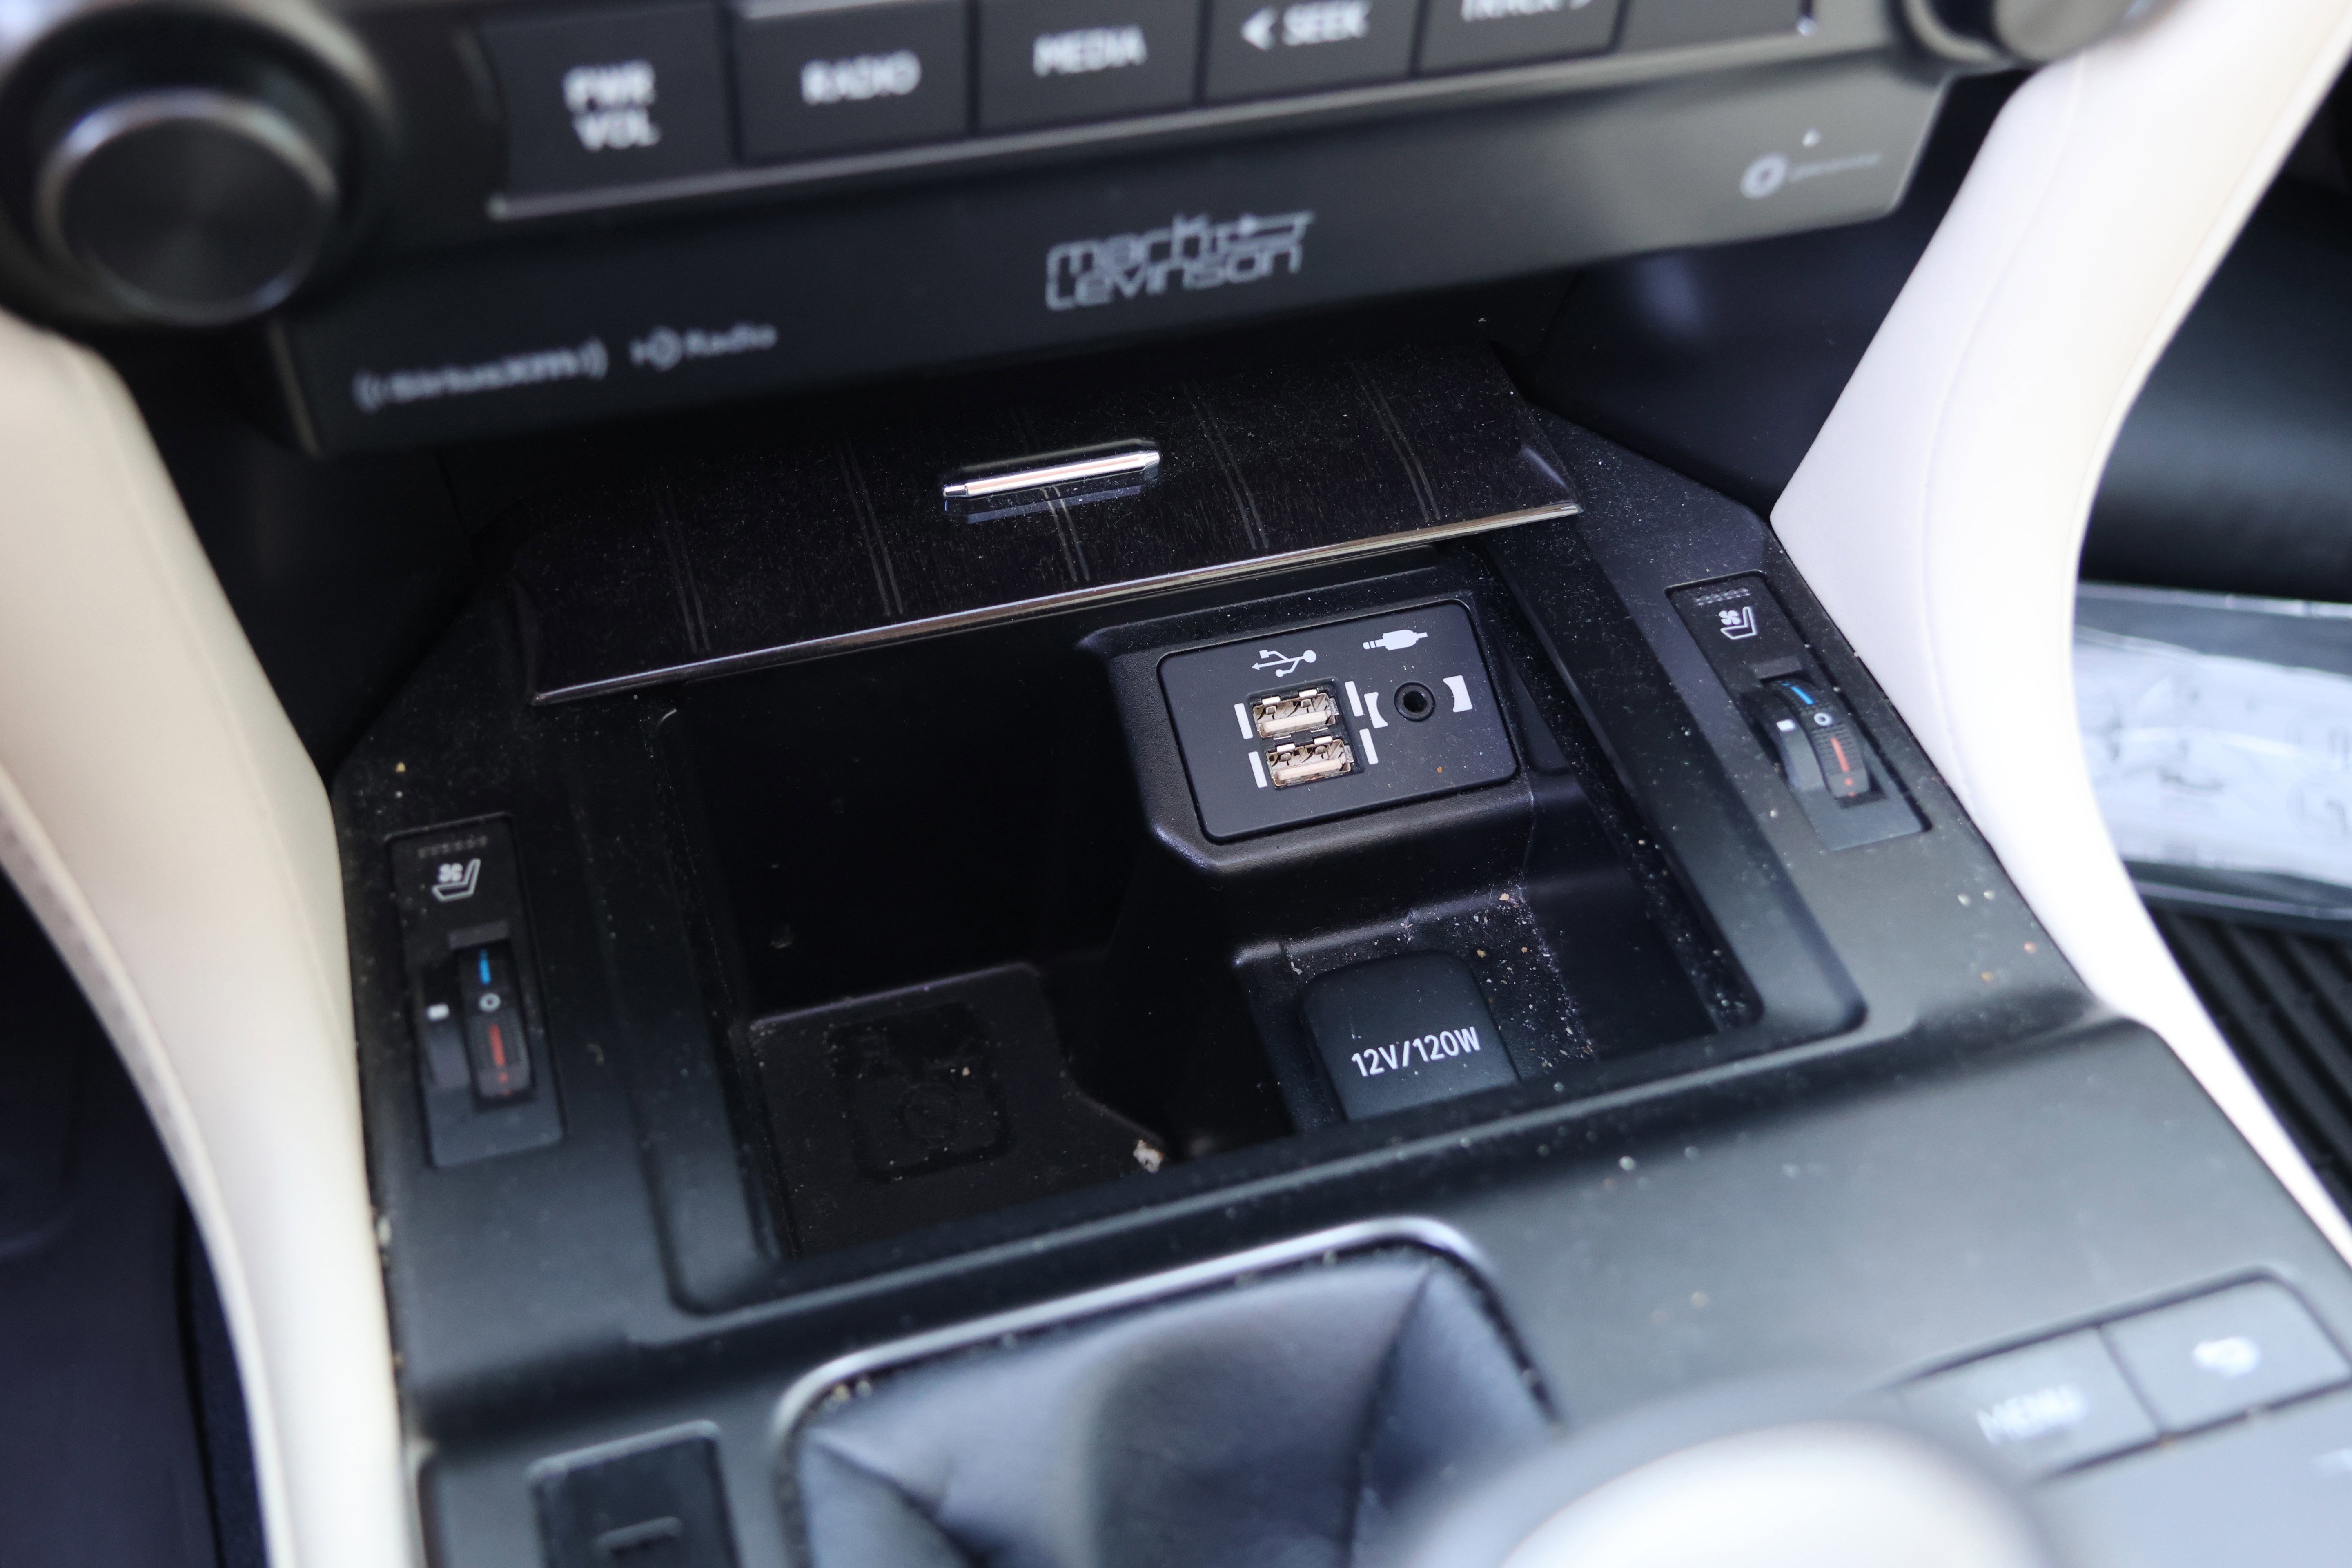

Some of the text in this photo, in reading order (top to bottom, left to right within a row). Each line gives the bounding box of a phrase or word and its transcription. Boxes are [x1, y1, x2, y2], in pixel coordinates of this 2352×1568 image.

[1033, 25, 1147, 76] MEDIA
[801, 50, 921, 105] RADIO
[574, 109, 659, 151] VOL
[1352, 1026, 1481, 1077] 12V/120W
